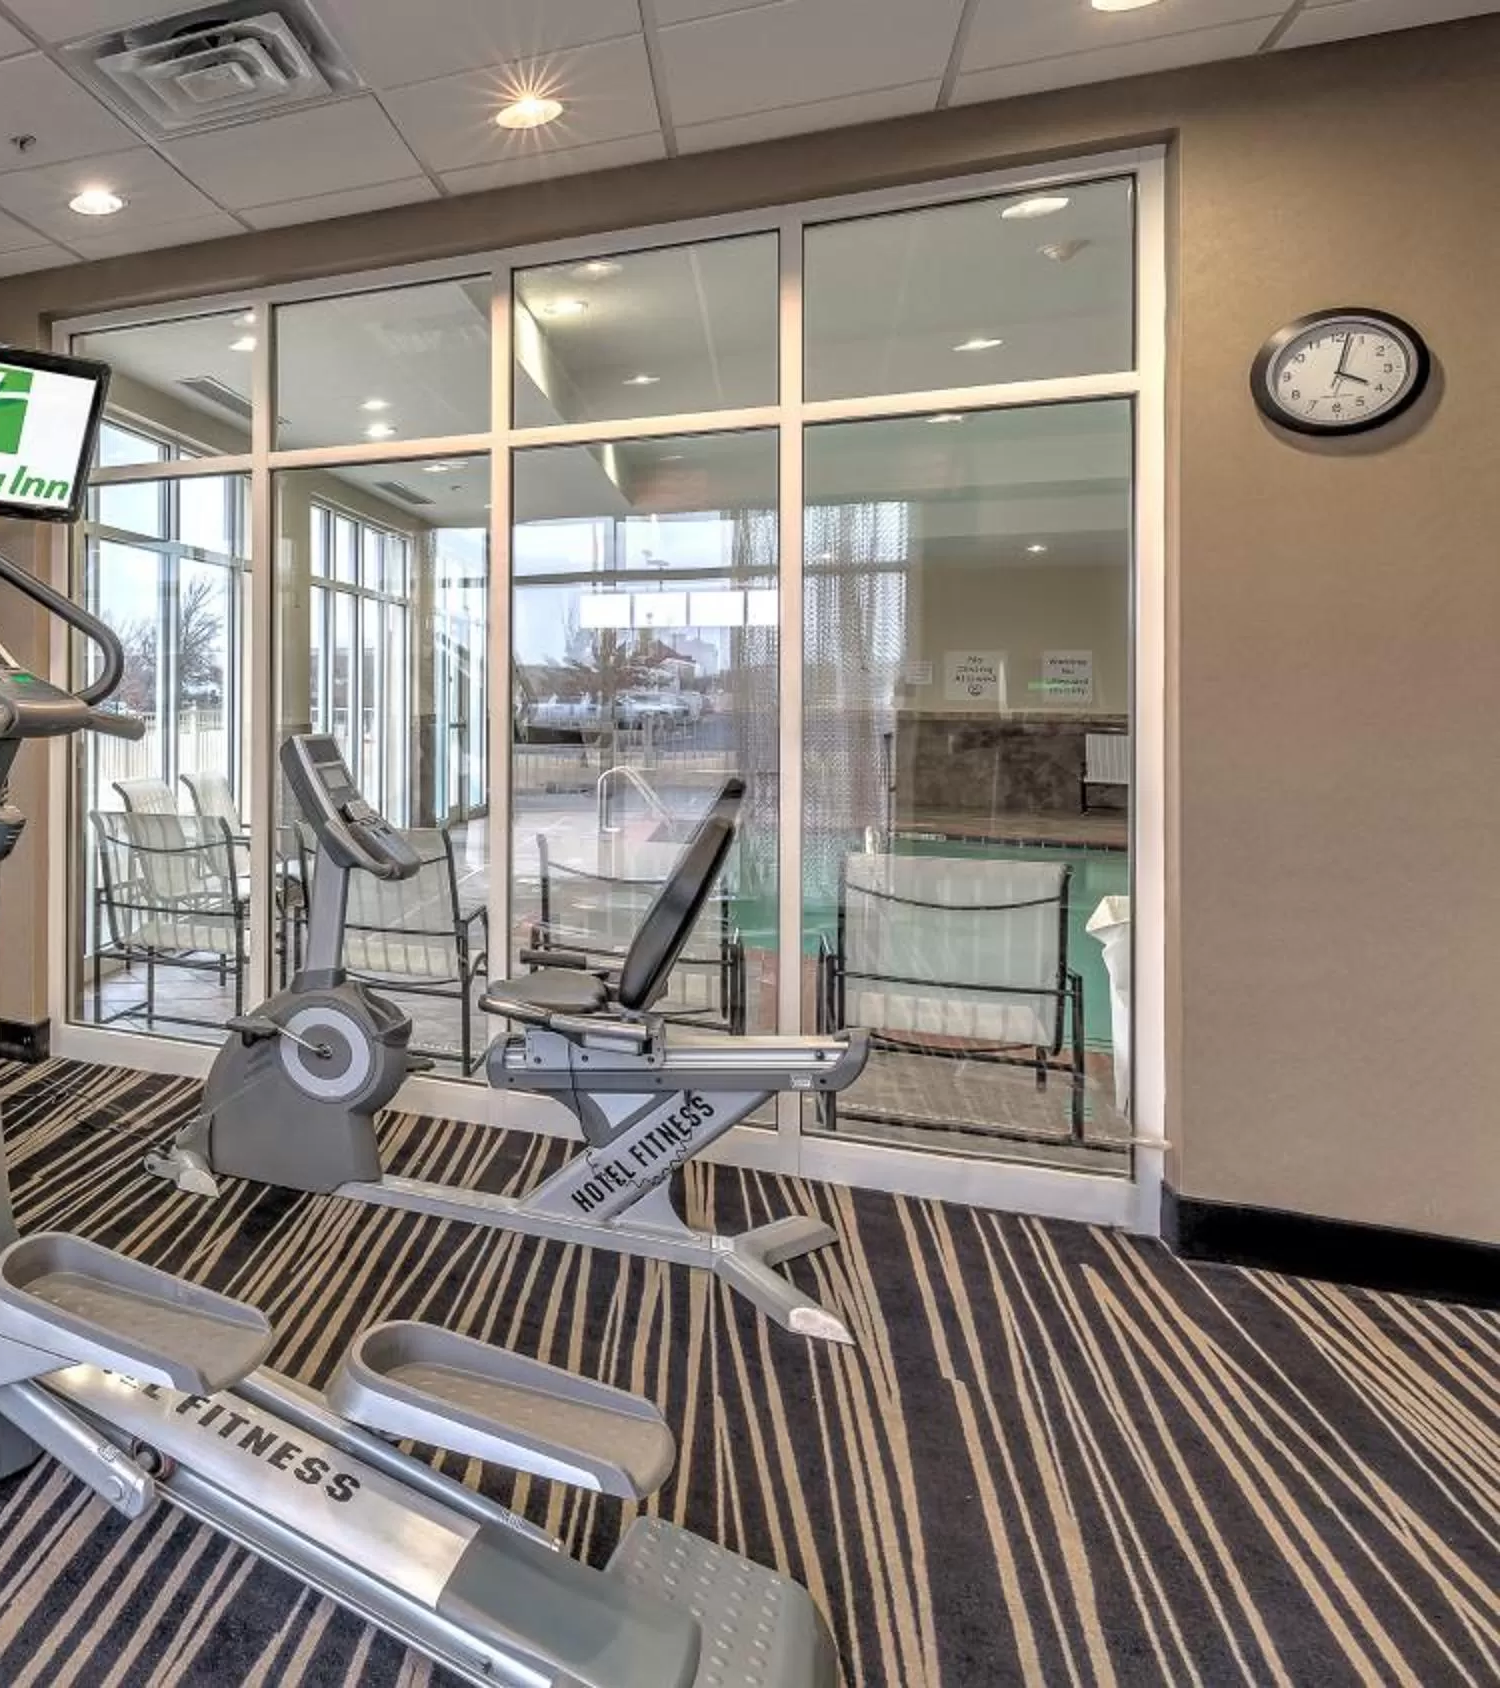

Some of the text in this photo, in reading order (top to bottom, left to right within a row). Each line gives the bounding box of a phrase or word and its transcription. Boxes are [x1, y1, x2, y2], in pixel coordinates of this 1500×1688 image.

[1331, 332, 1345, 343] 12
[1375, 345, 1386, 358] 2
[1382, 363, 1393, 373] 3
[1282, 371, 1292, 383] 9
[1374, 383, 1384, 393] 4
[1291, 389, 1301, 400] 8
[1355, 396, 1366, 407] 5
[8, 465, 70, 501] Inn
[571, 1095, 715, 1213] HOTEL FITNESS
[175, 1394, 361, 1503] FITNESS
